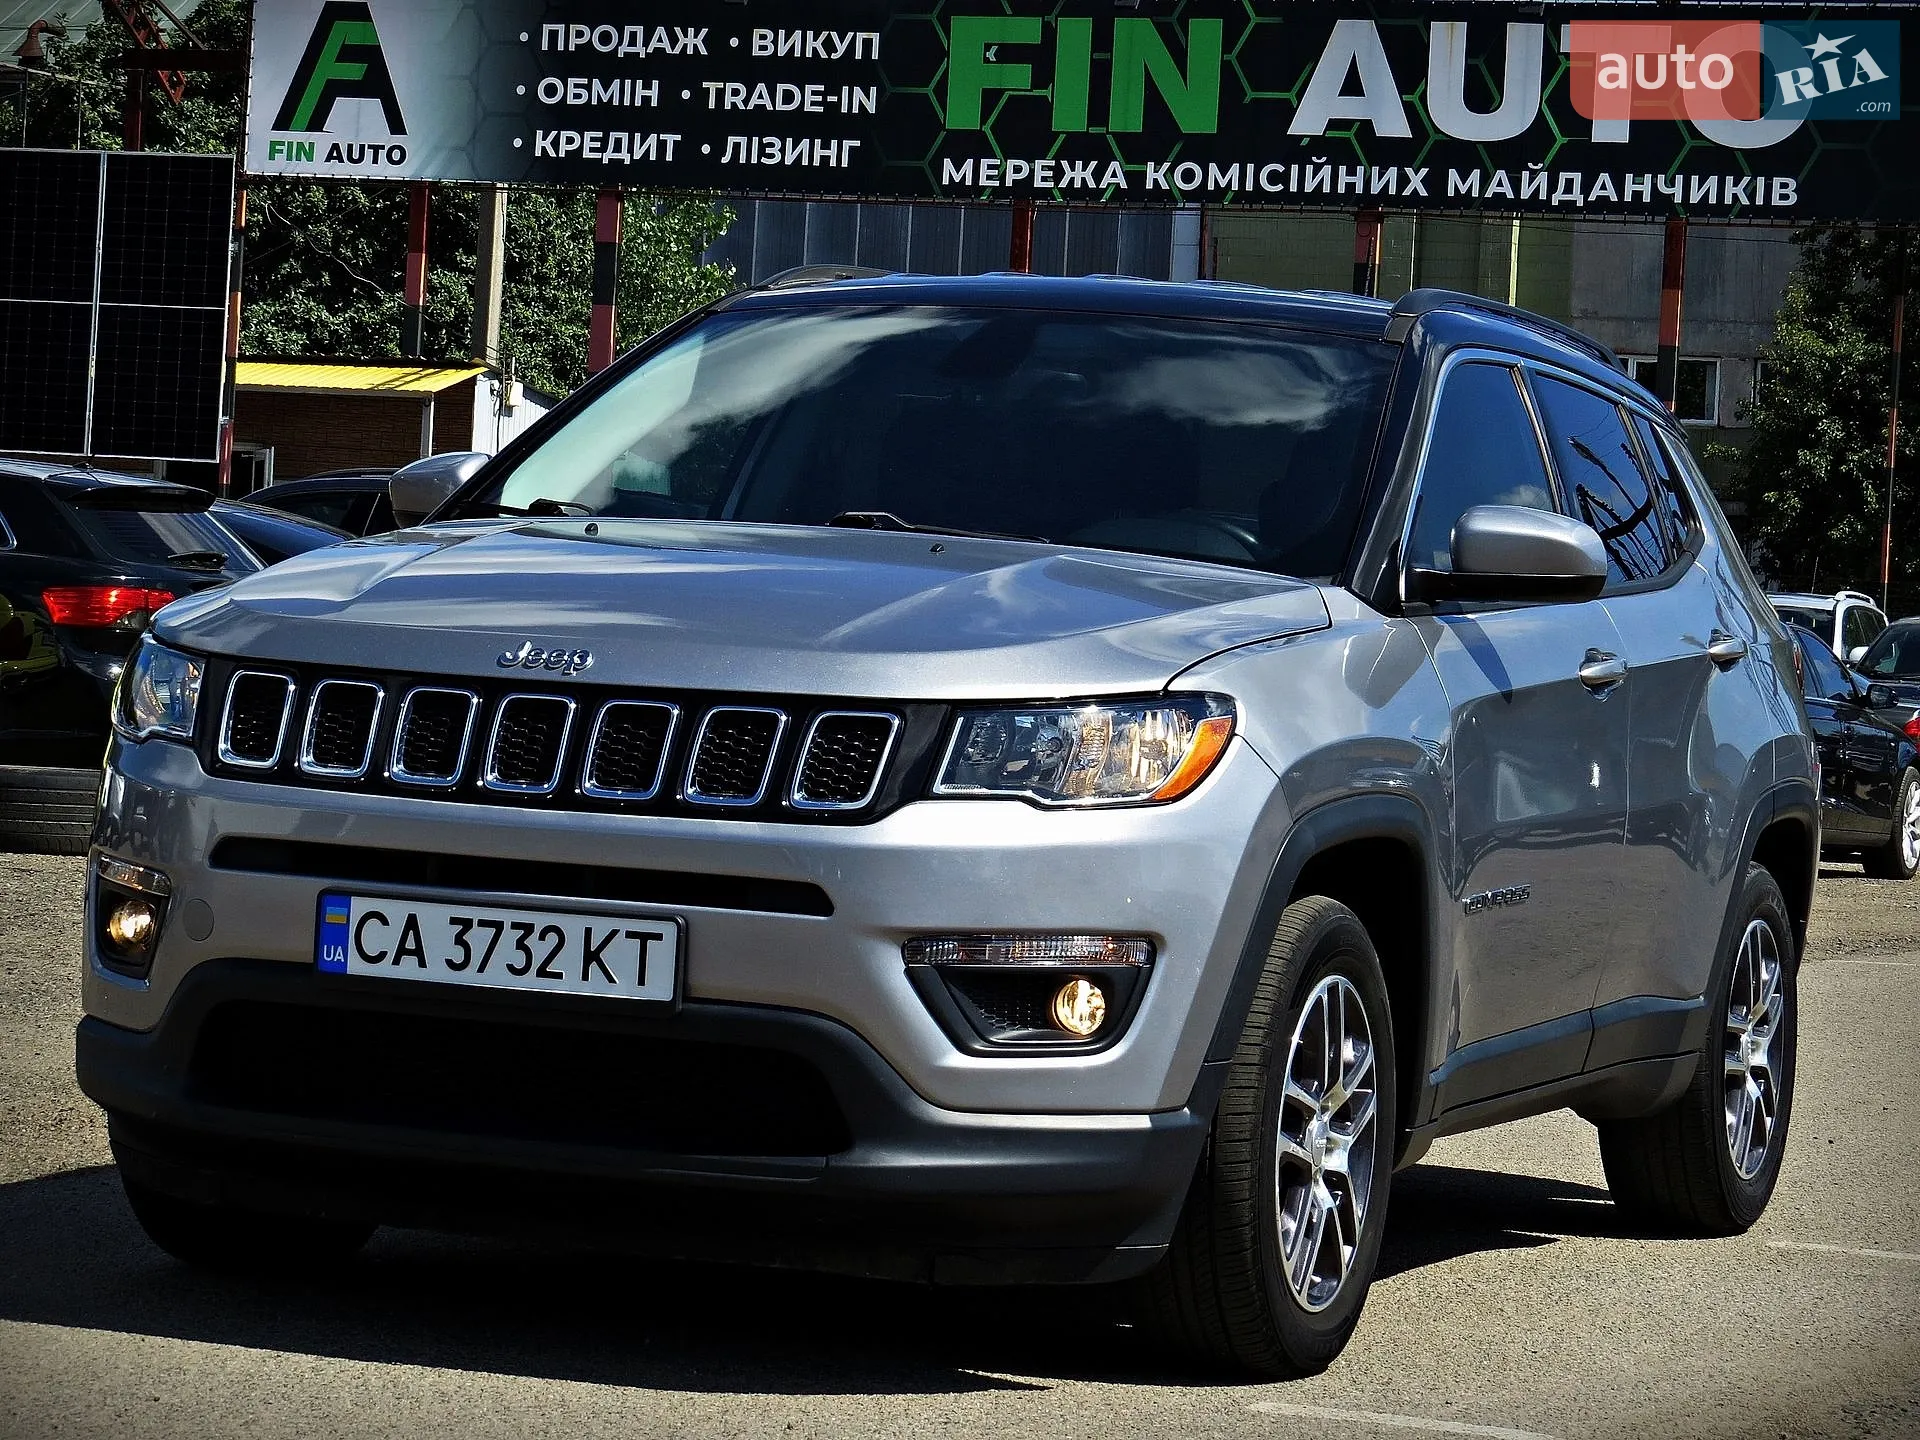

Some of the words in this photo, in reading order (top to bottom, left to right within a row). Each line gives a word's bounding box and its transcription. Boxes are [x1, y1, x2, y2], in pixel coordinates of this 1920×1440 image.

[540, 23, 709, 58] ПРОДАЖ
[751, 28, 880, 60] ВИКУП
[536, 76, 660, 107] ОБМІН
[702, 81, 878, 115] TRADE-IN
[945, 15, 1224, 134] FIN
[1286, 18, 1812, 149] AUTO
[268, 140, 316, 163] FIN
[323, 142, 408, 166] AUTO
[534, 129, 682, 164] КРЕДИТ
[721, 135, 861, 168] ЛІЗИНГ
[941, 157, 1129, 190] МЕРЕЖА
[1145, 156, 1430, 197] КОМІСІЙНИХ
[1447, 162, 1799, 207] МАЙДАНЧИКІВ
[496, 640, 595, 677] Jeep
[323, 943, 345, 964] UA
[353, 910, 429, 970] CA
[443, 916, 567, 981] 3732
[580, 926, 665, 987] KT
